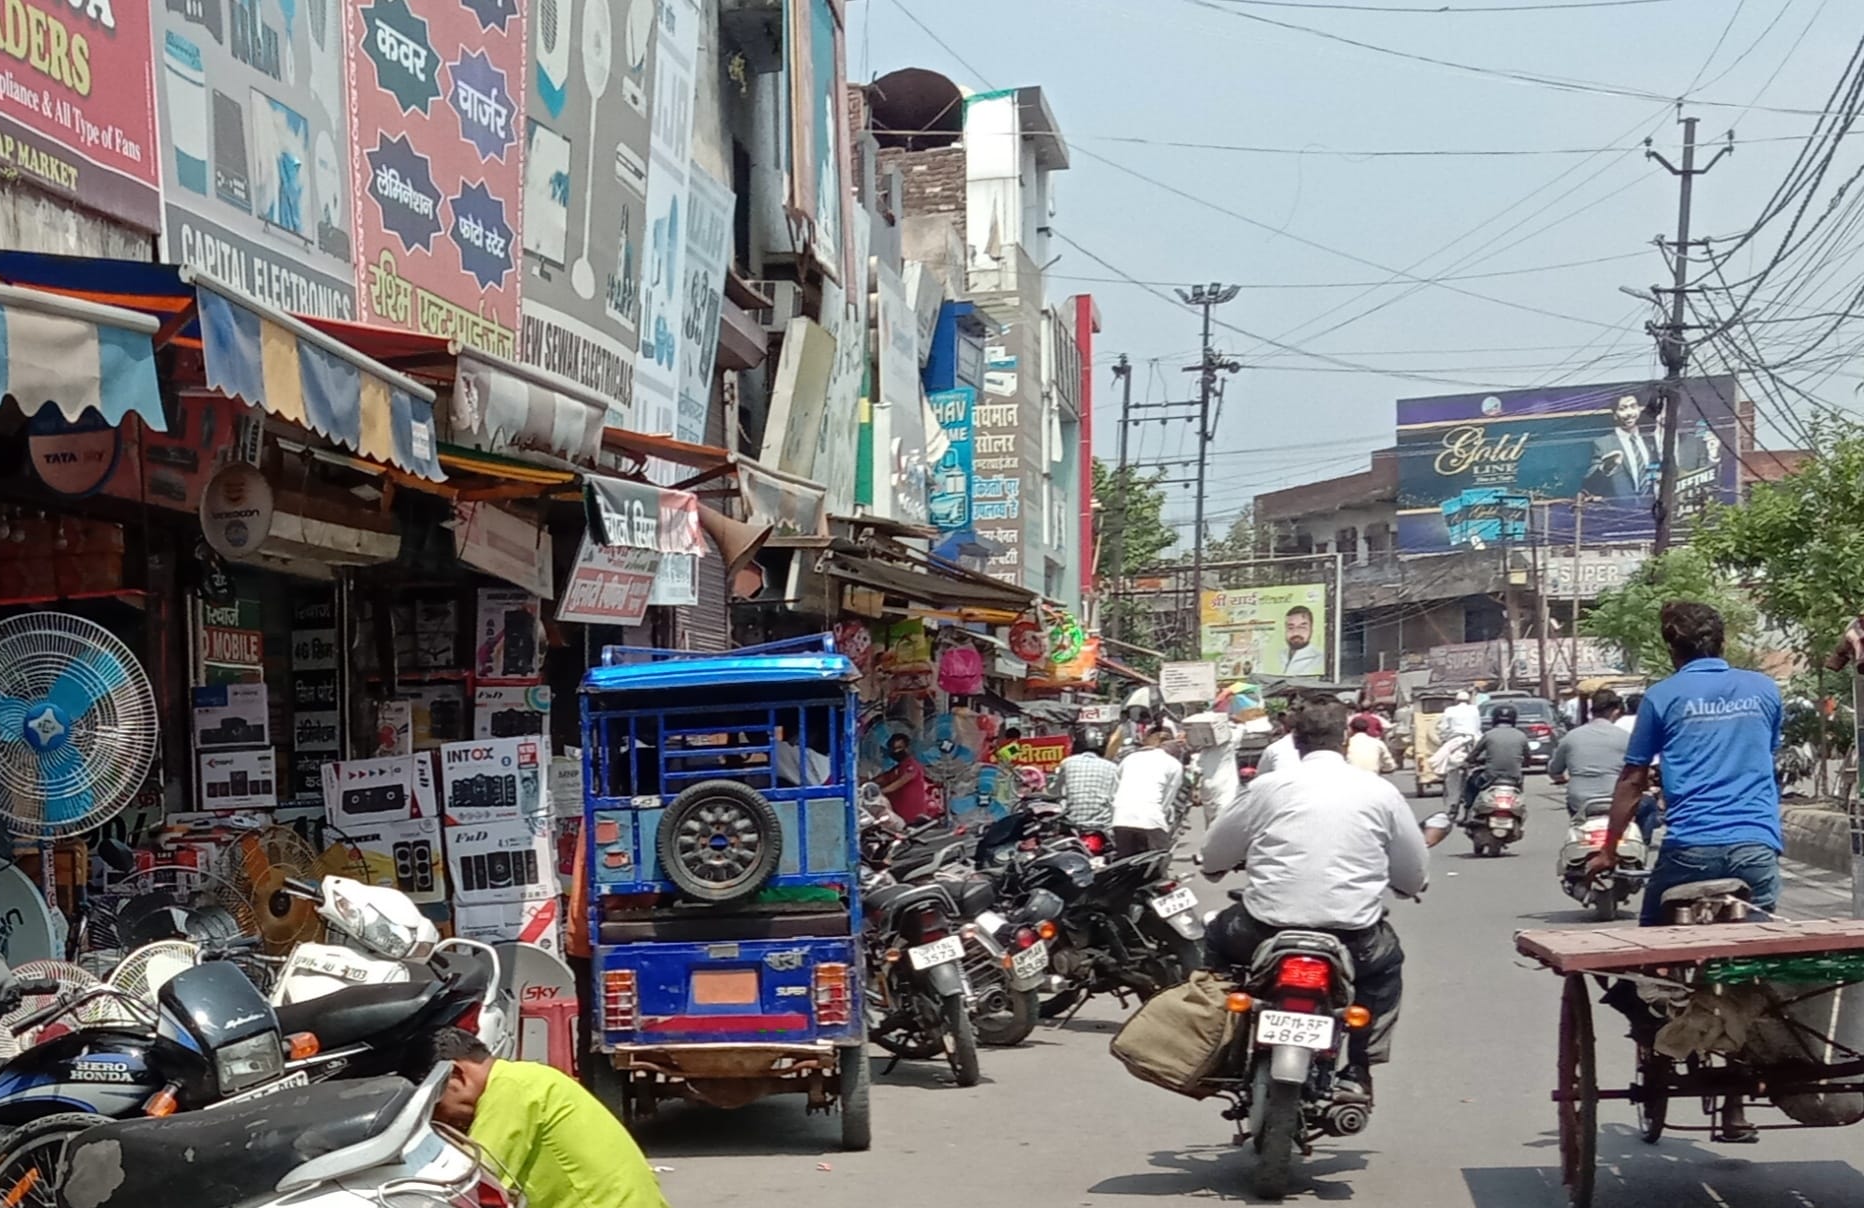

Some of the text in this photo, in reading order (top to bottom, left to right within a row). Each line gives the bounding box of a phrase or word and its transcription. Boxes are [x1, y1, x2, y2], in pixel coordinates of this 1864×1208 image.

[375, 18, 428, 82] कवर
[42, 90, 53, 119] &
[55, 98, 71, 130] All
[72, 109, 100, 150] Type
[101, 125, 114, 148] of
[114, 126, 142, 162] Fans
[457, 80, 508, 139] चार्जर
[17, 141, 79, 192] MARKET
[375, 164, 434, 221] लेमिनेशन
[458, 213, 506, 259] फोटो स्टेट
[180, 223, 353, 321] CAPITAL ELECTRONICS
[368, 248, 413, 329] रश्मि
[545, 322, 582, 383] SEWAK
[581, 339, 634, 409] ELECTRICALS
[933, 401, 967, 424] HAV
[44, 453, 78, 464] TATA
[975, 431, 1016, 453] सोलर
[1434, 426, 1530, 476] Gold
[1472, 463, 1519, 474] LINE
[213, 631, 259, 662] MOBILE
[447, 747, 494, 763] INTOX
[776, 986, 808, 997] SUPER
[1263, 1028, 1321, 1044] 4867
[70, 1070, 135, 1083] HONDA
[76, 1061, 128, 1073] HERO
